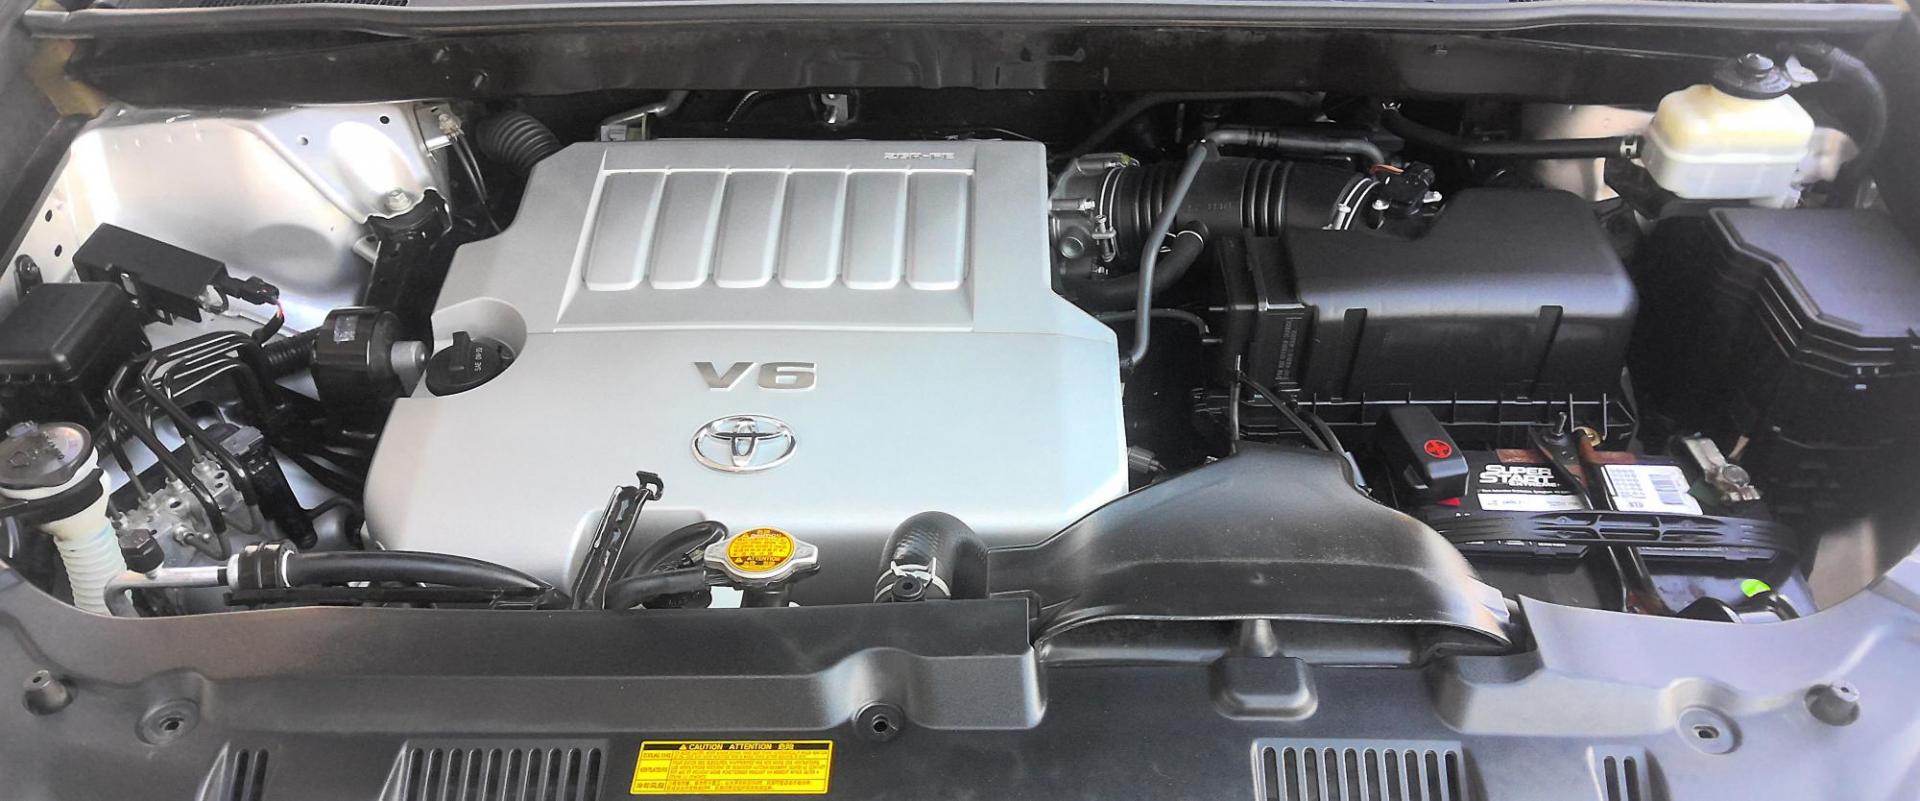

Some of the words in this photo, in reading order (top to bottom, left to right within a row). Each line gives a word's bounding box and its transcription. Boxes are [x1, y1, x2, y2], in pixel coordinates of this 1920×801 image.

[693, 361, 817, 391] V6
[1485, 464, 1552, 476] SUPER
[1479, 472, 1555, 484] START
